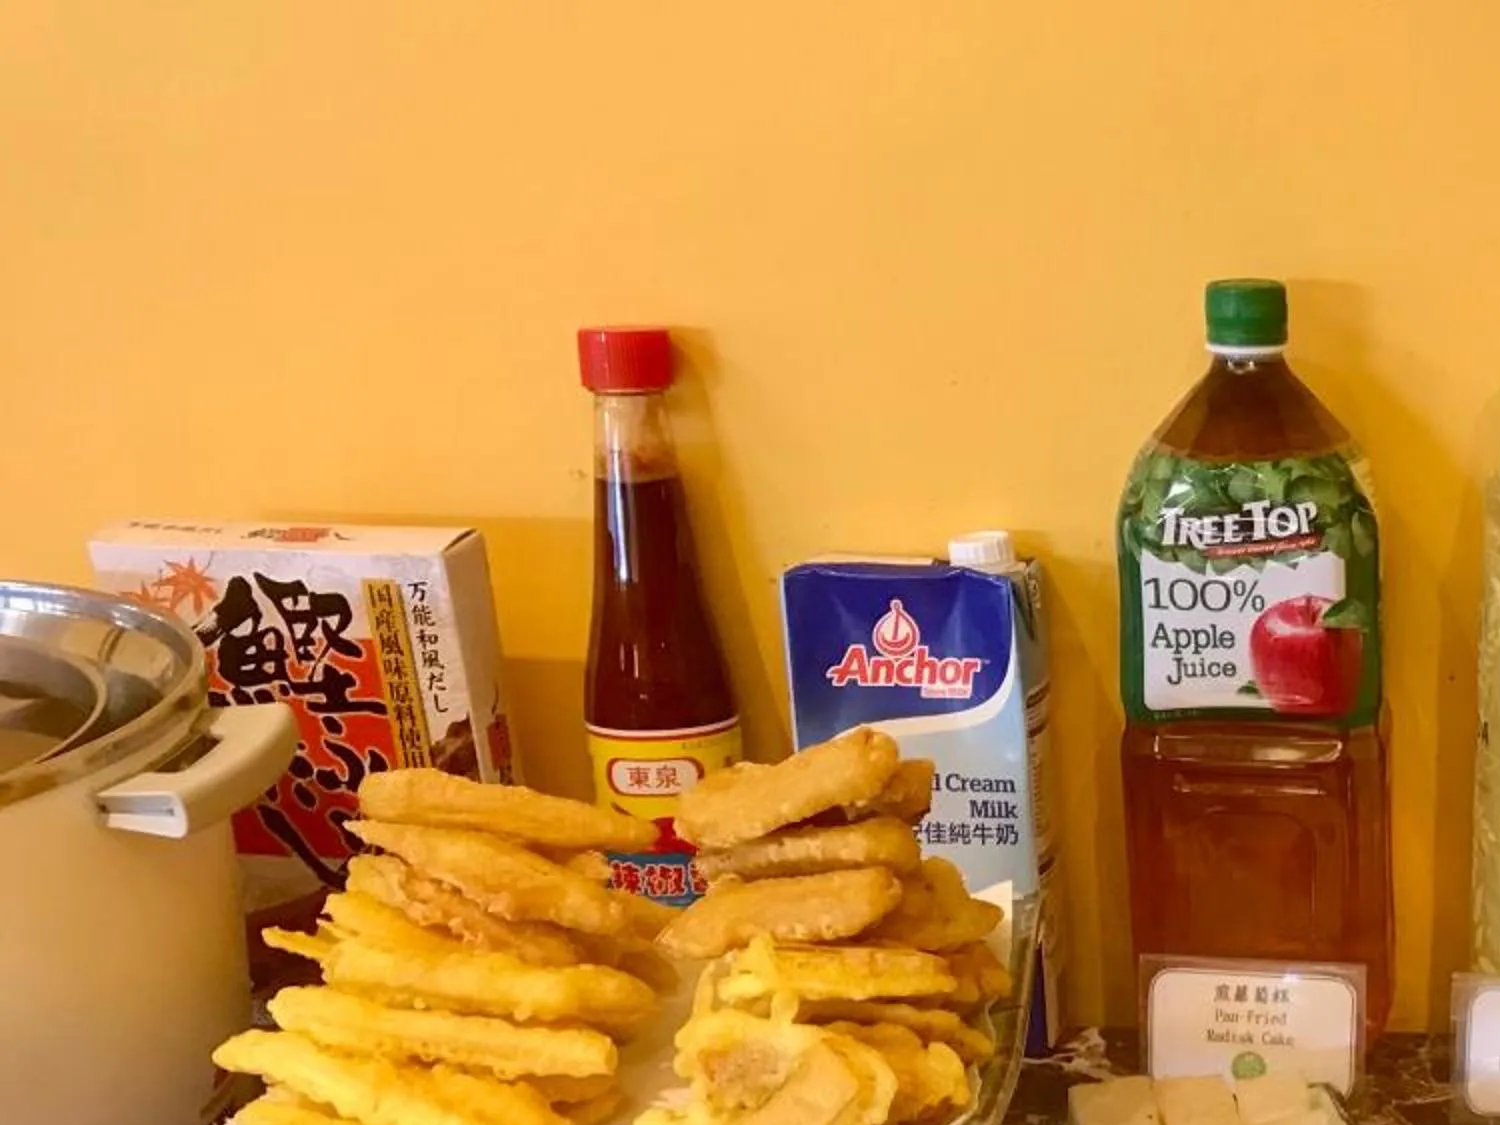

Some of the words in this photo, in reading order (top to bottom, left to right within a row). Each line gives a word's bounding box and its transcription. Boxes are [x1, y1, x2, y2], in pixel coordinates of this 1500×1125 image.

[1144, 576, 1266, 613] 100%
[407, 580, 449, 714] 万能和風だし
[1151, 623, 1235, 655] Apple
[827, 644, 982, 687] Anchor
[1167, 656, 1237, 685] Juice
[626, 766, 681, 789] 東泉
[945, 773, 1016, 793] Cream
[970, 800, 1018, 819] Milk
